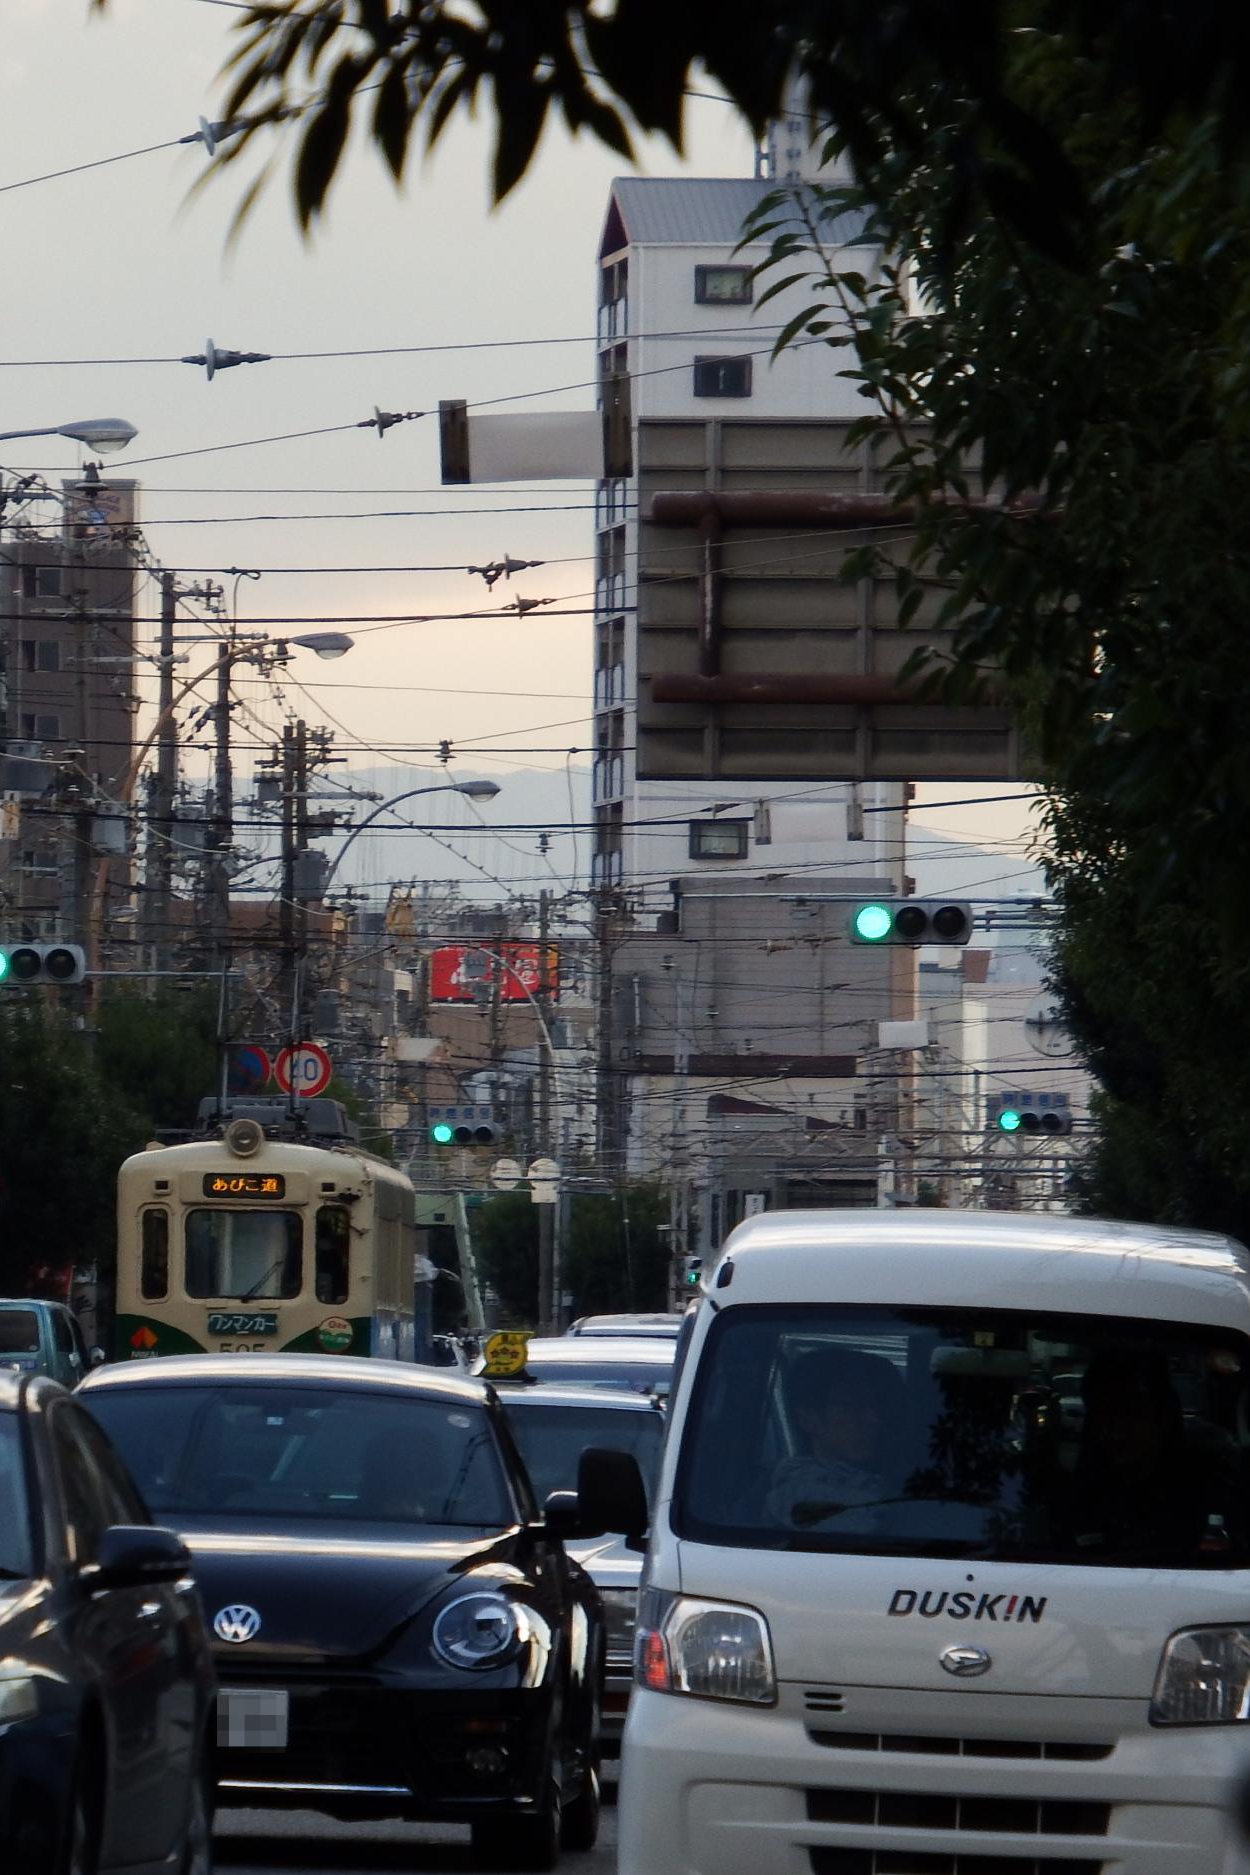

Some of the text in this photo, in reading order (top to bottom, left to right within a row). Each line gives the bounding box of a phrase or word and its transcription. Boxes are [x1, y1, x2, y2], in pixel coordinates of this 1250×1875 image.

[212, 1178, 278, 1192] あびこ道
[210, 1315, 276, 1331] ワンマンカー
